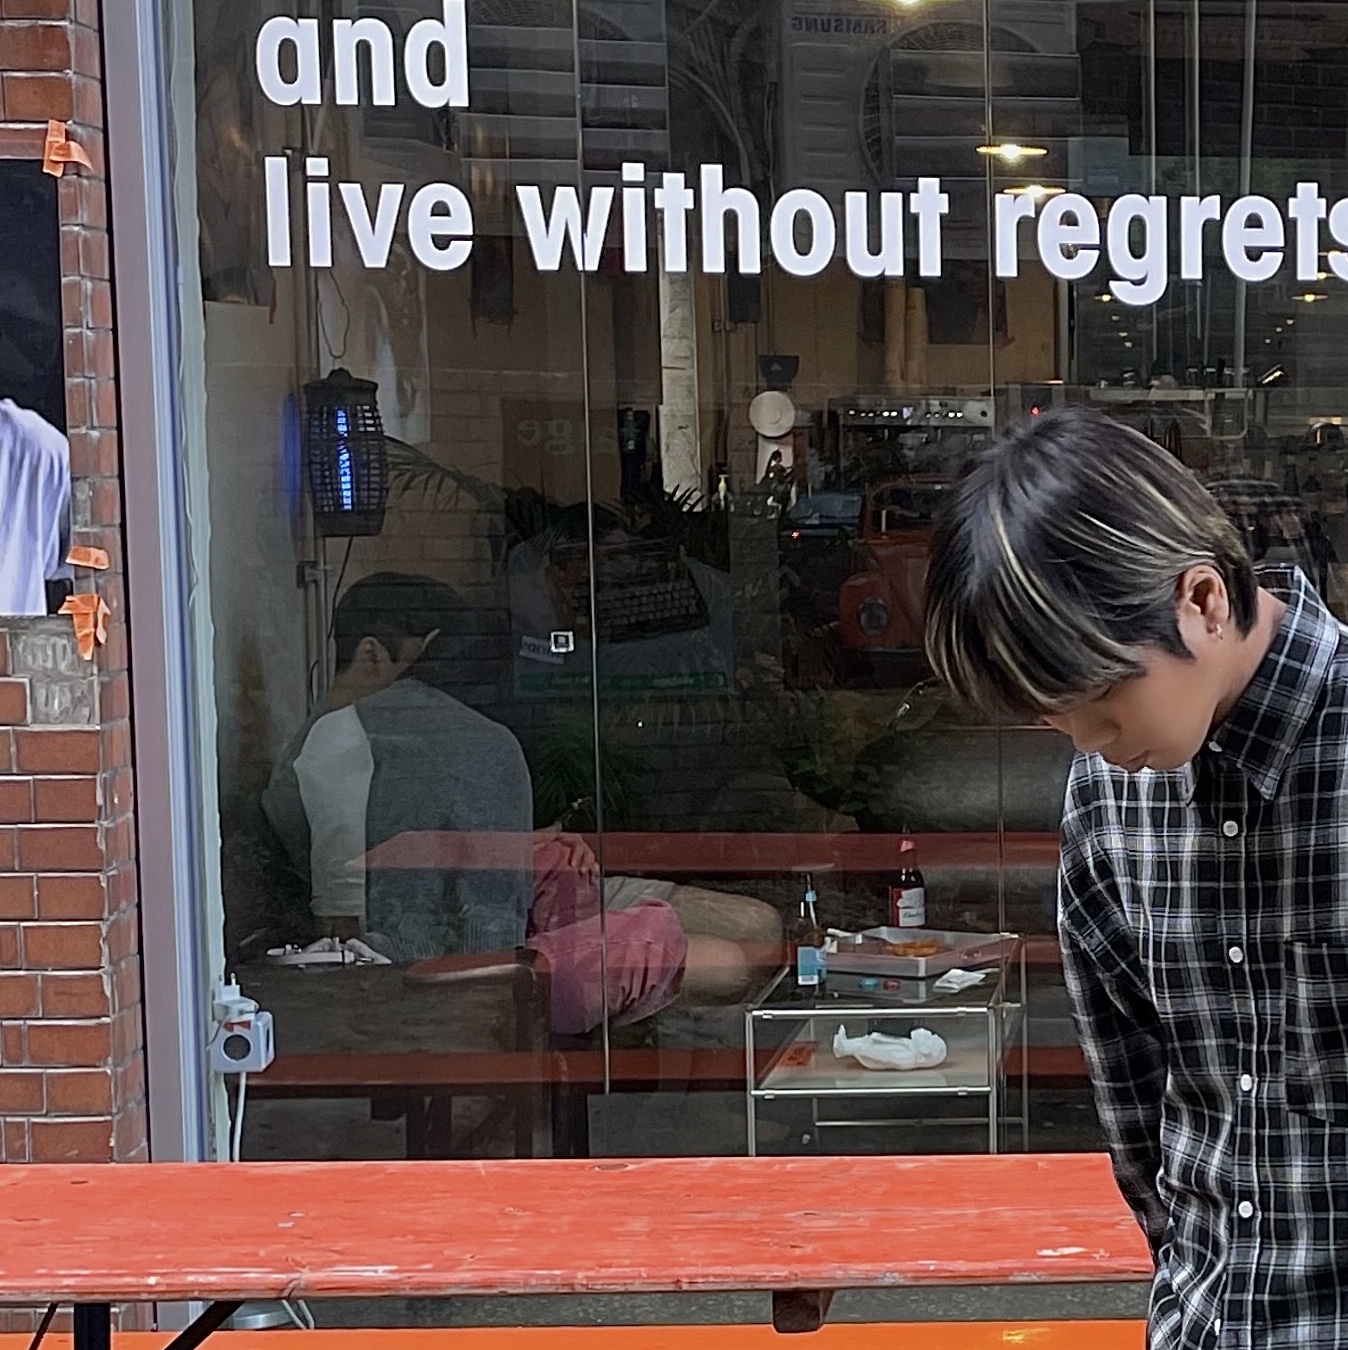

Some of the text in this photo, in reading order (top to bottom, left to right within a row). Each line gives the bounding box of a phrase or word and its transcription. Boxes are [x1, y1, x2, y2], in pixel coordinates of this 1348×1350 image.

[256, 0, 469, 108] and
[264, 156, 474, 271] live
[515, 163, 949, 278] without
